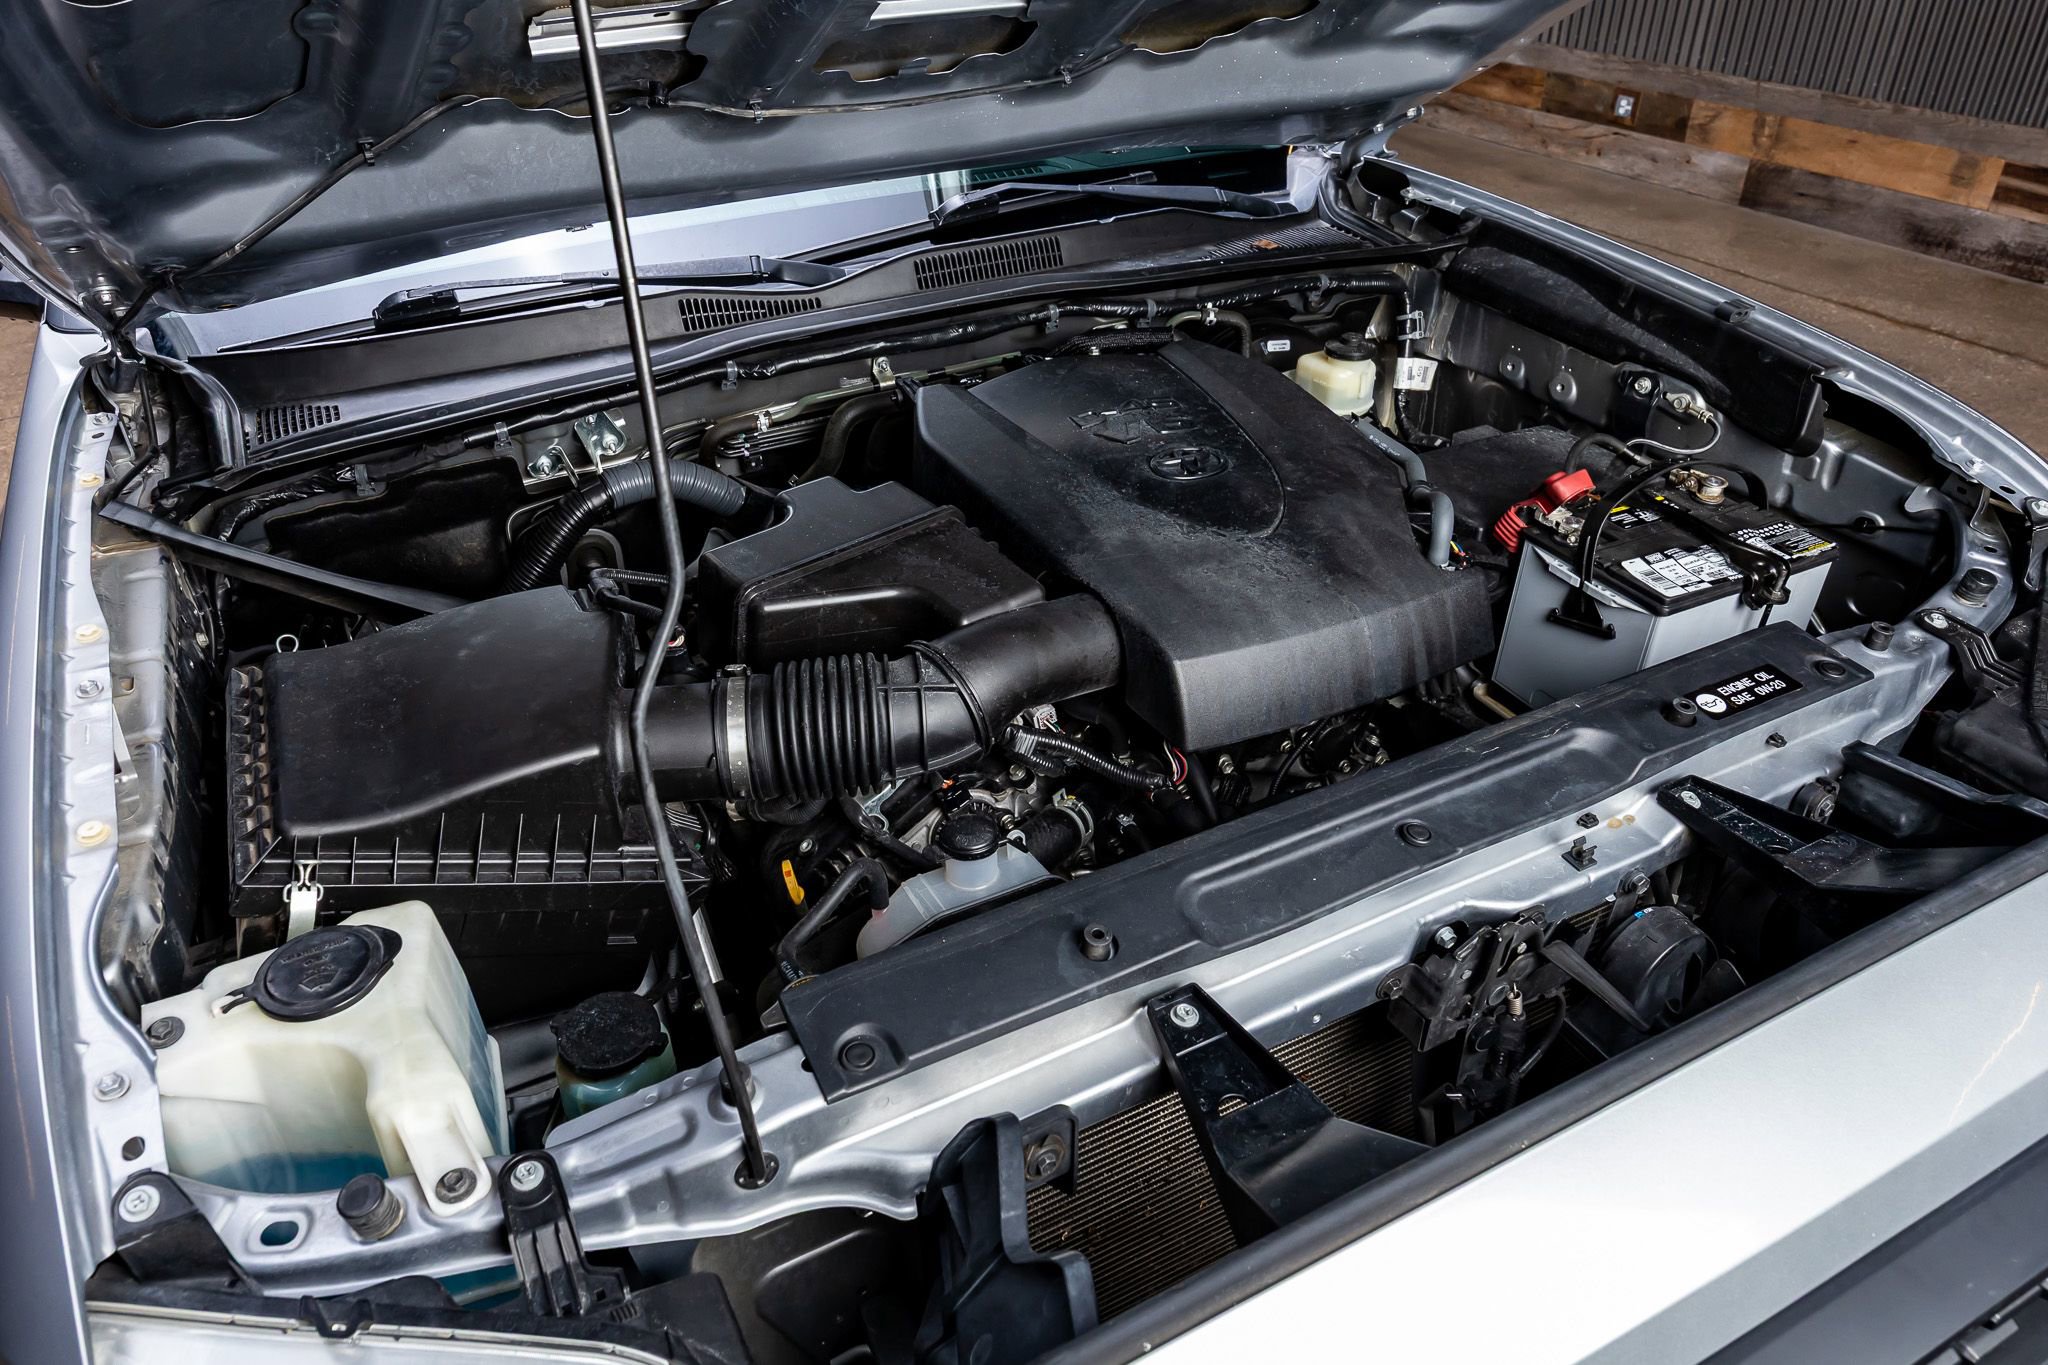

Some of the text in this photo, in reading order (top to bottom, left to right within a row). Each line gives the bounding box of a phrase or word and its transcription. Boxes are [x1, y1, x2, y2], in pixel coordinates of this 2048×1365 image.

[1716, 671, 1775, 696] ENGINE OIL
[1730, 679, 1787, 705] SAE 0W-20
